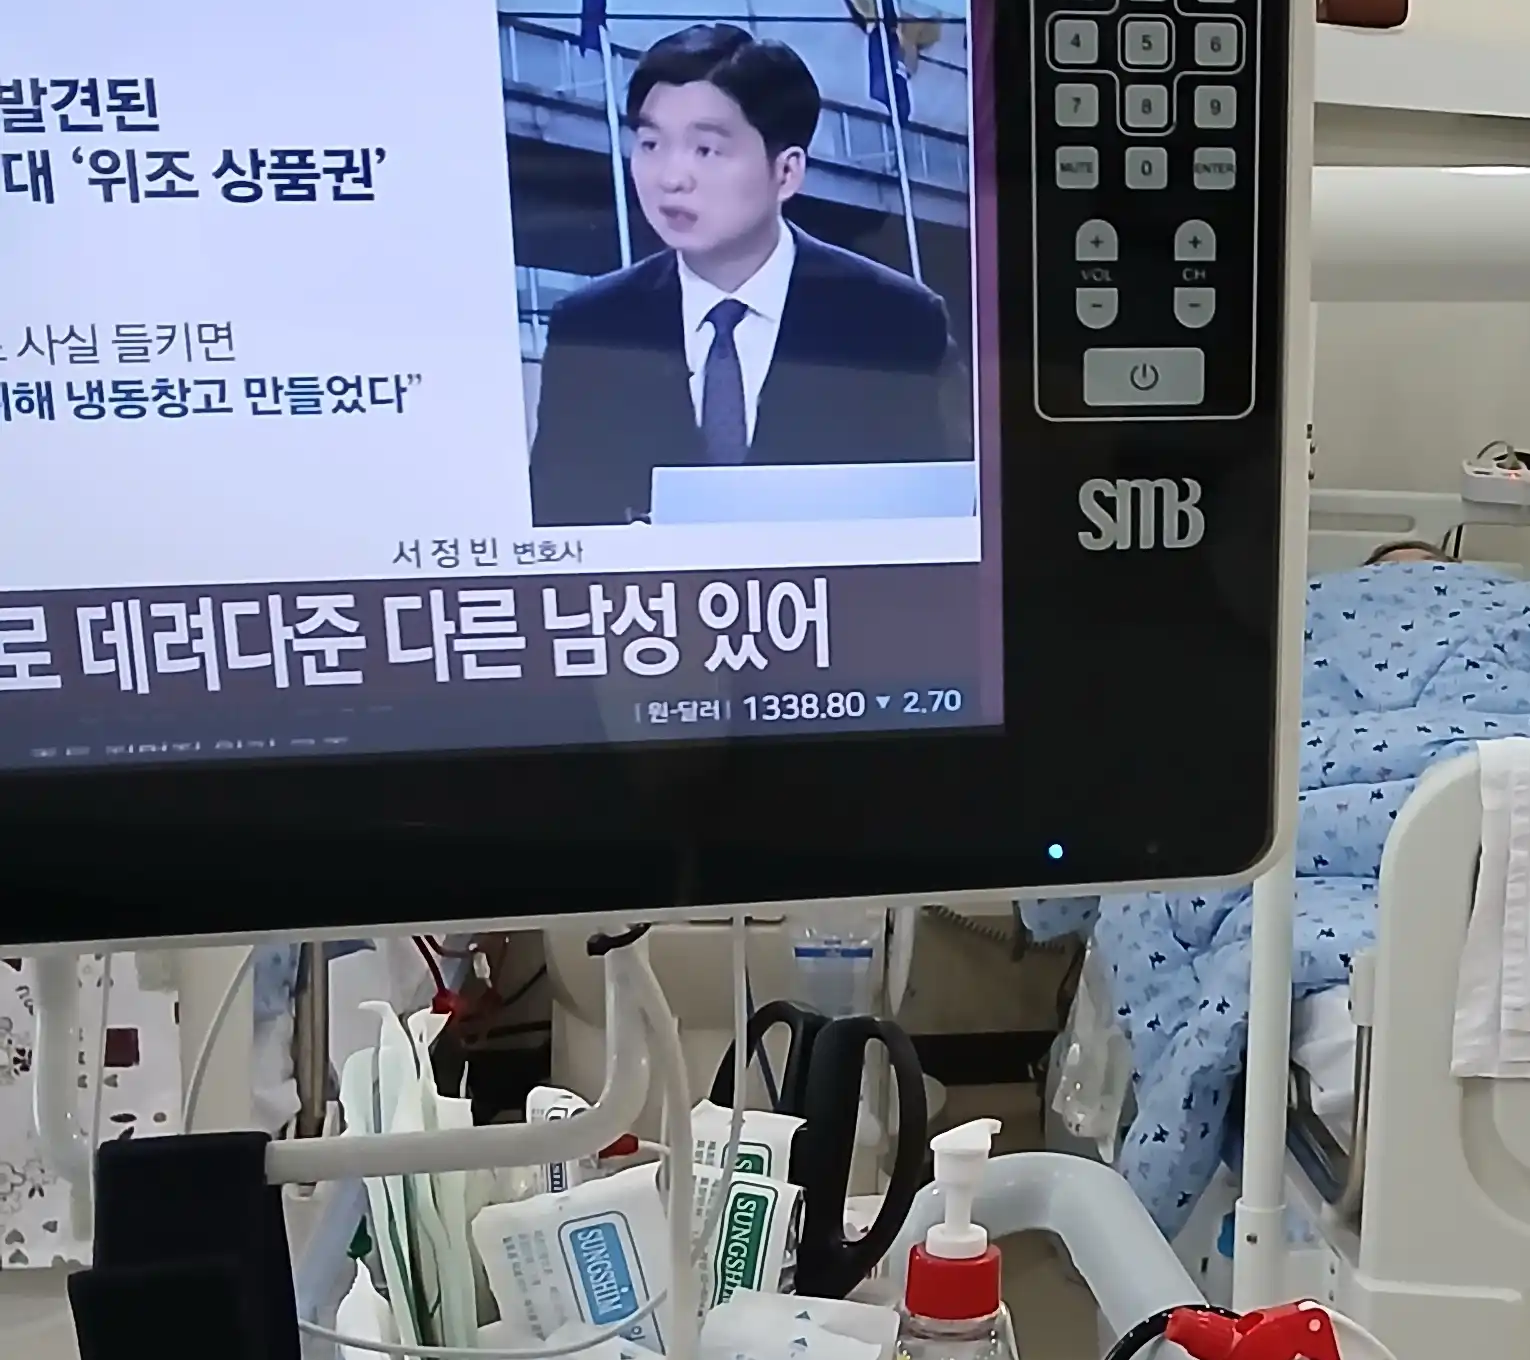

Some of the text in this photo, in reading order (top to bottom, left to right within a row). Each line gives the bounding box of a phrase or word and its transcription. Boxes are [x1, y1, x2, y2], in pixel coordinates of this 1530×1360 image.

[1070, 33, 1081, 48] 4
[1142, 36, 1152, 51] 5
[1210, 37, 1221, 52] 6
[0, 77, 160, 133] 발견된
[1072, 98, 1081, 112] 7
[1142, 99, 1152, 114] 8
[1210, 99, 1221, 114] 9
[1060, 162, 1093, 173] MUTE
[1141, 160, 1152, 175] 0
[1195, 162, 1235, 173] ENTER
[1081, 269, 1112, 281] VOL
[1182, 269, 1206, 281] CH
[17, 321, 236, 366] 사실 들키면
[66, 378, 234, 420] 냉동창고
[1078, 478, 1205, 550] SMB
[513, 540, 584, 565] 변호사
[0, 577, 830, 694] 로 데려다준 다른 남성 있어
[743, 691, 866, 721] 1338.80
[902, 689, 962, 714] 2.70
